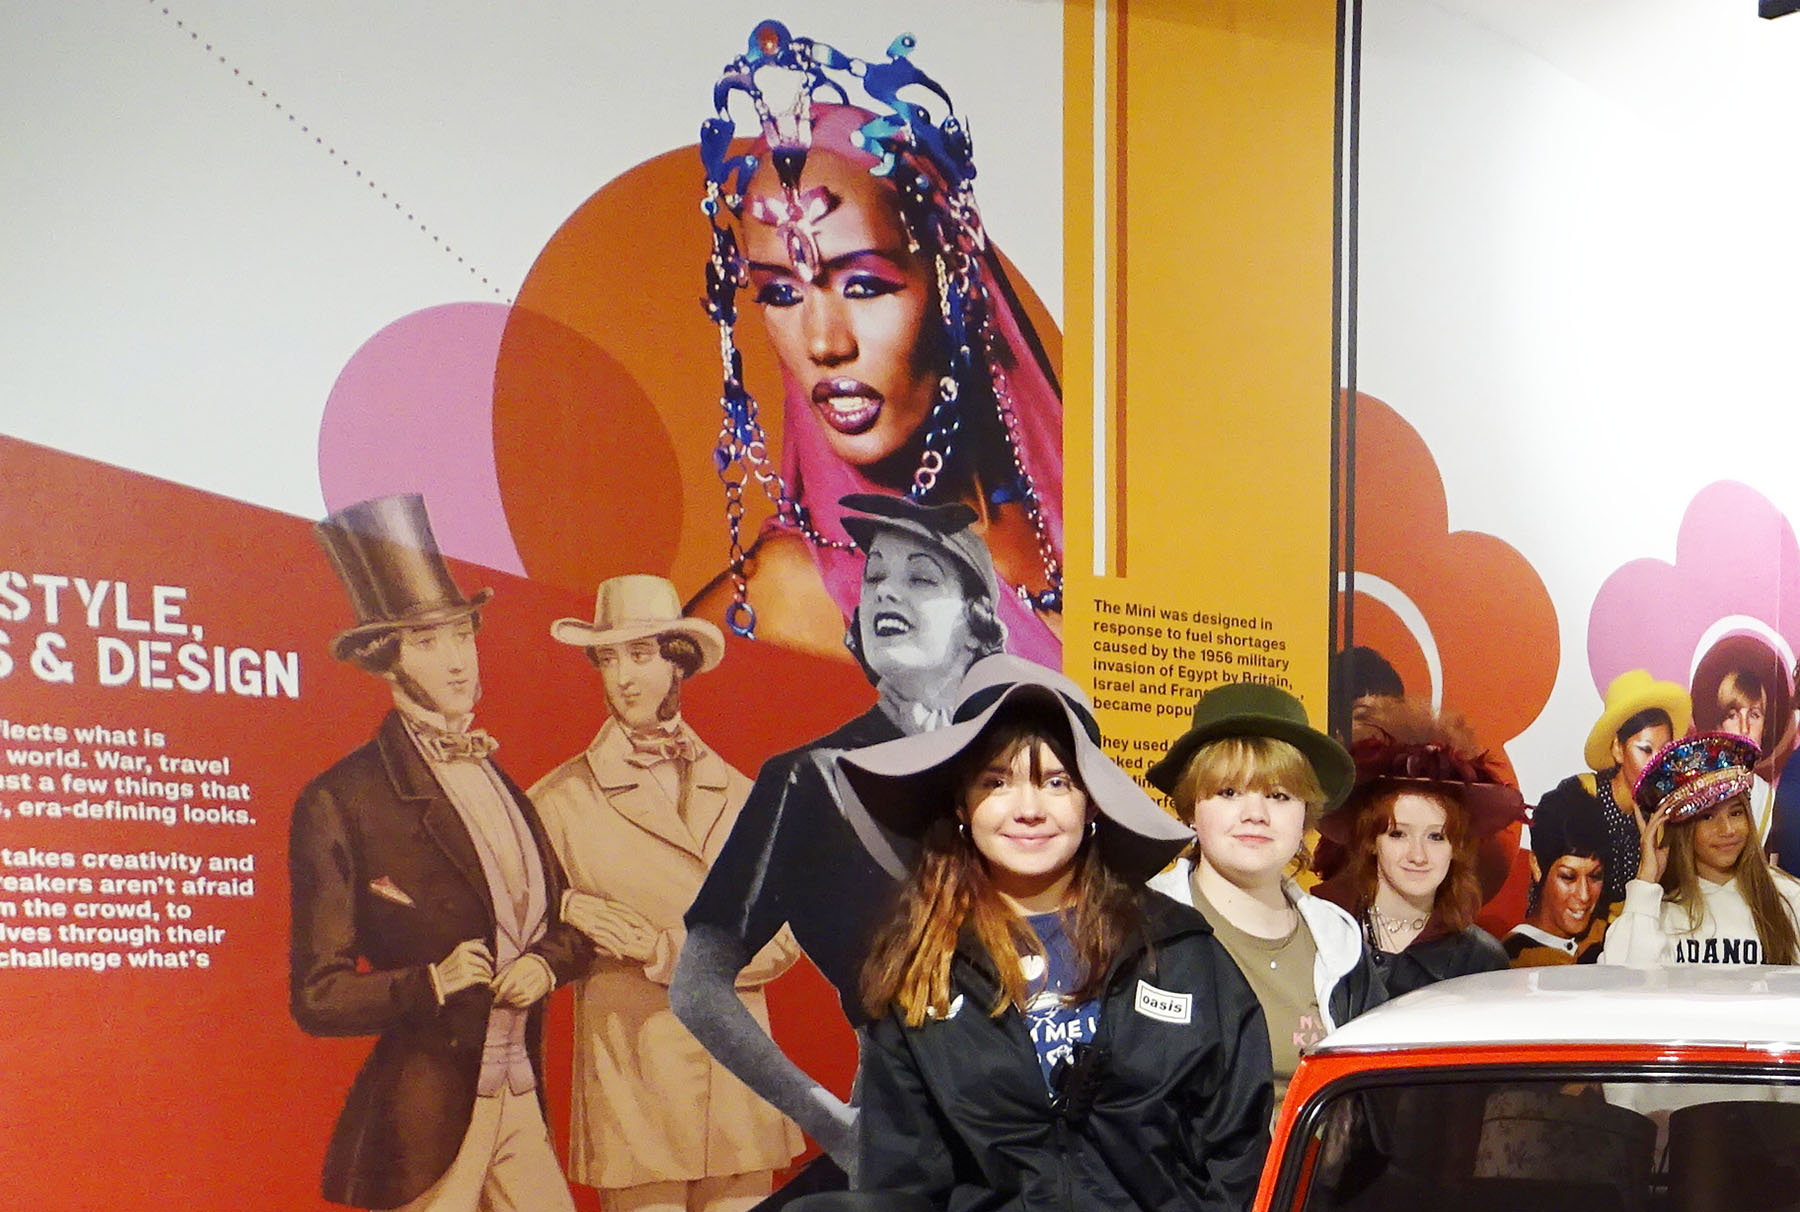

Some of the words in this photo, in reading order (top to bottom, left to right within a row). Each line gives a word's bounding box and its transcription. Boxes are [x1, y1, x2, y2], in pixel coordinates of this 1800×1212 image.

[0, 571, 204, 641] STYLE,
[1093, 599, 1121, 615] The
[1125, 603, 1156, 619] Mini
[1160, 609, 1188, 622] was
[1192, 610, 1257, 629] designed
[1261, 617, 1273, 630] in
[1093, 621, 1163, 637] response
[1167, 627, 1182, 640] to
[1186, 628, 1212, 643] fuel
[1216, 632, 1287, 652] shortages
[30, 631, 75, 683] &
[98, 636, 300, 698] DESIGN
[1093, 640, 1147, 655] caused
[1151, 643, 1168, 661] by
[1173, 646, 1196, 661] the
[1200, 649, 1233, 664] 1956
[1237, 653, 1289, 672] military
[1093, 657, 1155, 676] invasion
[1159, 664, 1174, 677] of
[1178, 665, 1218, 683] Egypt
[1222, 669, 1239, 684] by
[1242, 671, 1293, 691] Britain,
[1093, 677, 1135, 693] Israel
[1139, 683, 1166, 695] and
[1093, 697, 1152, 713] became
[1156, 703, 1196, 718] popu
[73, 725, 137, 747] what
[144, 728, 166, 747] is
[1133, 739, 1169, 751] used
[5, 748, 88, 769] world.
[94, 750, 153, 775] War,
[159, 755, 230, 776] travel
[38, 775, 55, 793] a
[61, 773, 108, 795] few
[114, 776, 194, 801] things
[201, 781, 251, 801] that
[18, 799, 177, 826] era-defining
[183, 803, 257, 826] looks.
[0, 847, 76, 869] takes
[81, 851, 203, 875] creativity
[208, 855, 255, 873] and
[0, 873, 93, 894] eakers
[99, 876, 175, 896] aren’t
[182, 878, 254, 896] afraid
[22, 897, 67, 918] the
[73, 900, 160, 922] crowd,
[166, 902, 192, 919] to
[0, 922, 52, 943] lves
[58, 923, 161, 947] through
[167, 925, 226, 944] their
[0, 947, 122, 973] challenge
[128, 949, 210, 968] what’s
[1142, 995, 1183, 1013] oasis
